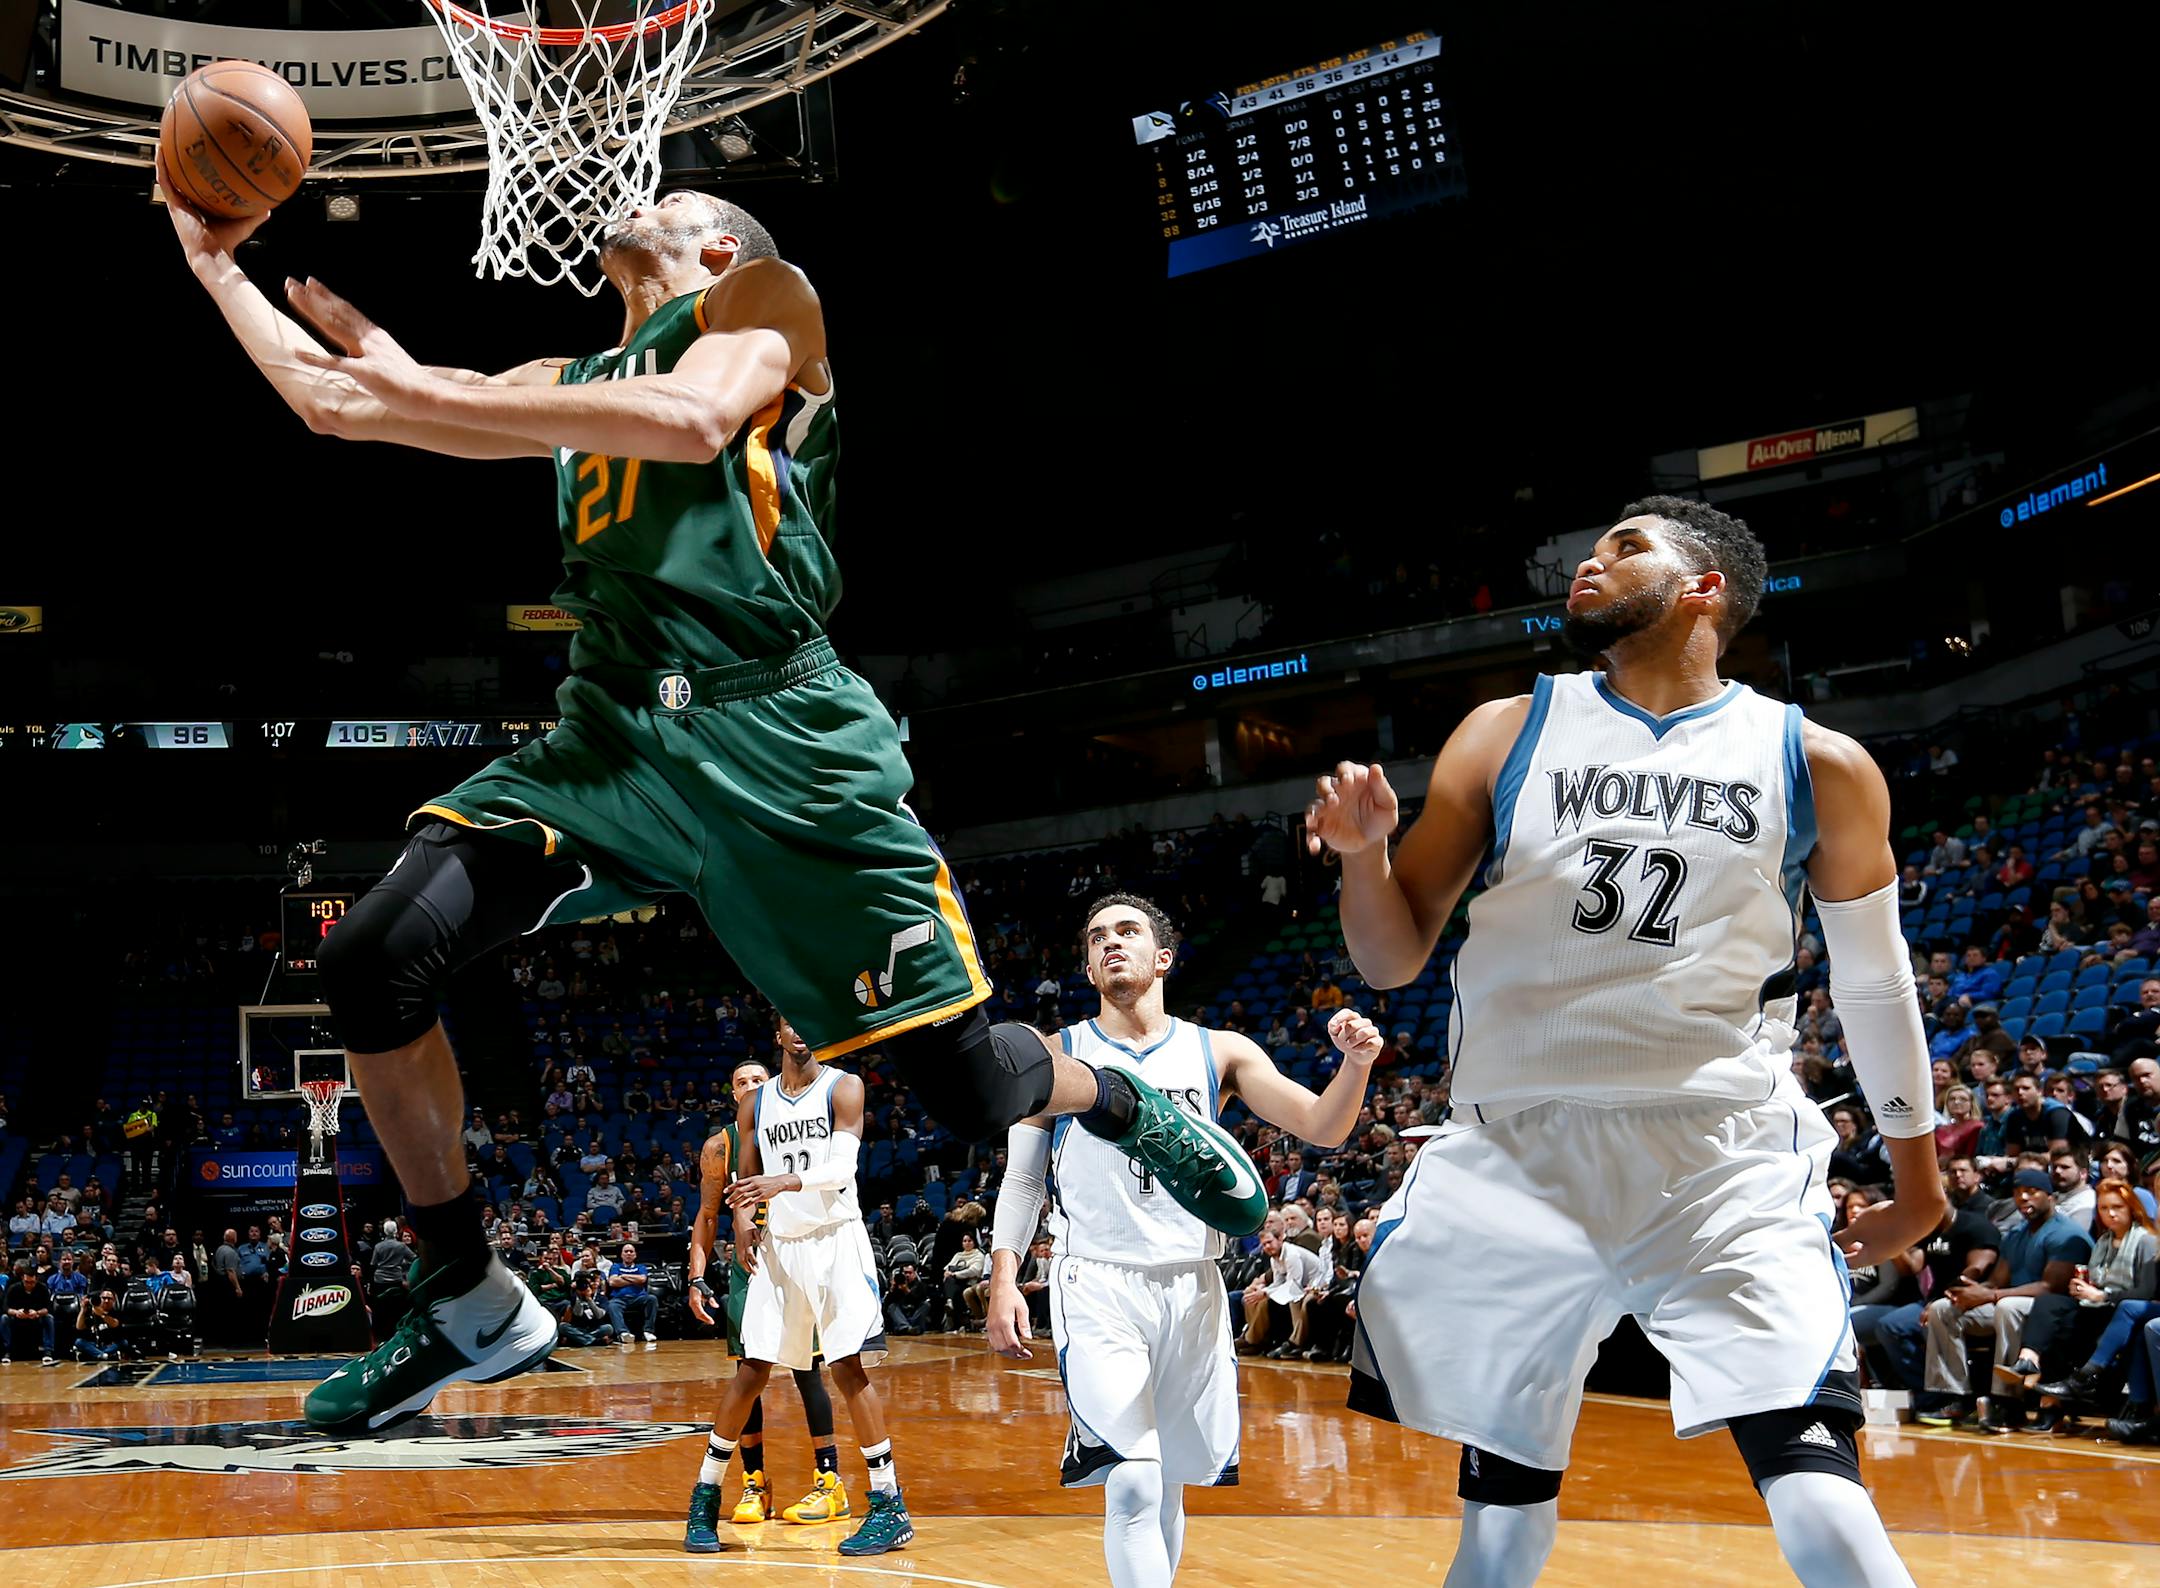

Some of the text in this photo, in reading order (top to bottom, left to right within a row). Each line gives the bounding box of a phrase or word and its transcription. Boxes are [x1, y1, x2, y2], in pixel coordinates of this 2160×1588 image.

[1347, 48, 1370, 62] AST
[1240, 45, 1424, 110] 43 41 96 36 23 14 7
[1156, 82, 1433, 172] 1 1/2 1/2 0/0 0 3 0 2 3
[1158, 98, 1440, 188] 8 8/14 2/4 7/8 0 5 8 2 25
[1158, 117, 1442, 205] 22 5/15 1/2 0/0 0 4 2 5 11
[1161, 133, 1446, 221] 32 6/16 1/3 1/1 1 1 11 4 14
[1163, 151, 1445, 238] 88 2/6 1/3 3/3 0 1 5 0 8
[1280, 193, 1367, 232] Treasure Island
[2016, 462, 2107, 522] element
[1521, 615, 1562, 634] TVs
[2129, 619, 2150, 636] 106
[1212, 654, 1308, 688] element
[25, 725, 46, 734] TOL
[174, 726, 208, 745] 96
[260, 722, 295, 739] 1:07
[338, 725, 388, 744] 105
[502, 722, 529, 731] Fouls
[272, 739, 279, 748] 4
[511, 734, 519, 744] 5
[1546, 764, 1762, 844] WOLVES
[258, 844, 278, 855] 101
[1571, 838, 1688, 947] 32
[311, 900, 345, 919] 1:07
[764, 1117, 828, 1152] WOLVES
[222, 1163, 250, 1179] sun
[252, 1160, 297, 1178] count
[307, 1207, 329, 1217] Ford
[307, 1231, 329, 1241] Ford
[307, 1255, 330, 1265] Ford
[294, 1290, 346, 1319] LIBMAN
[1800, 1433, 1838, 1448] adidas
